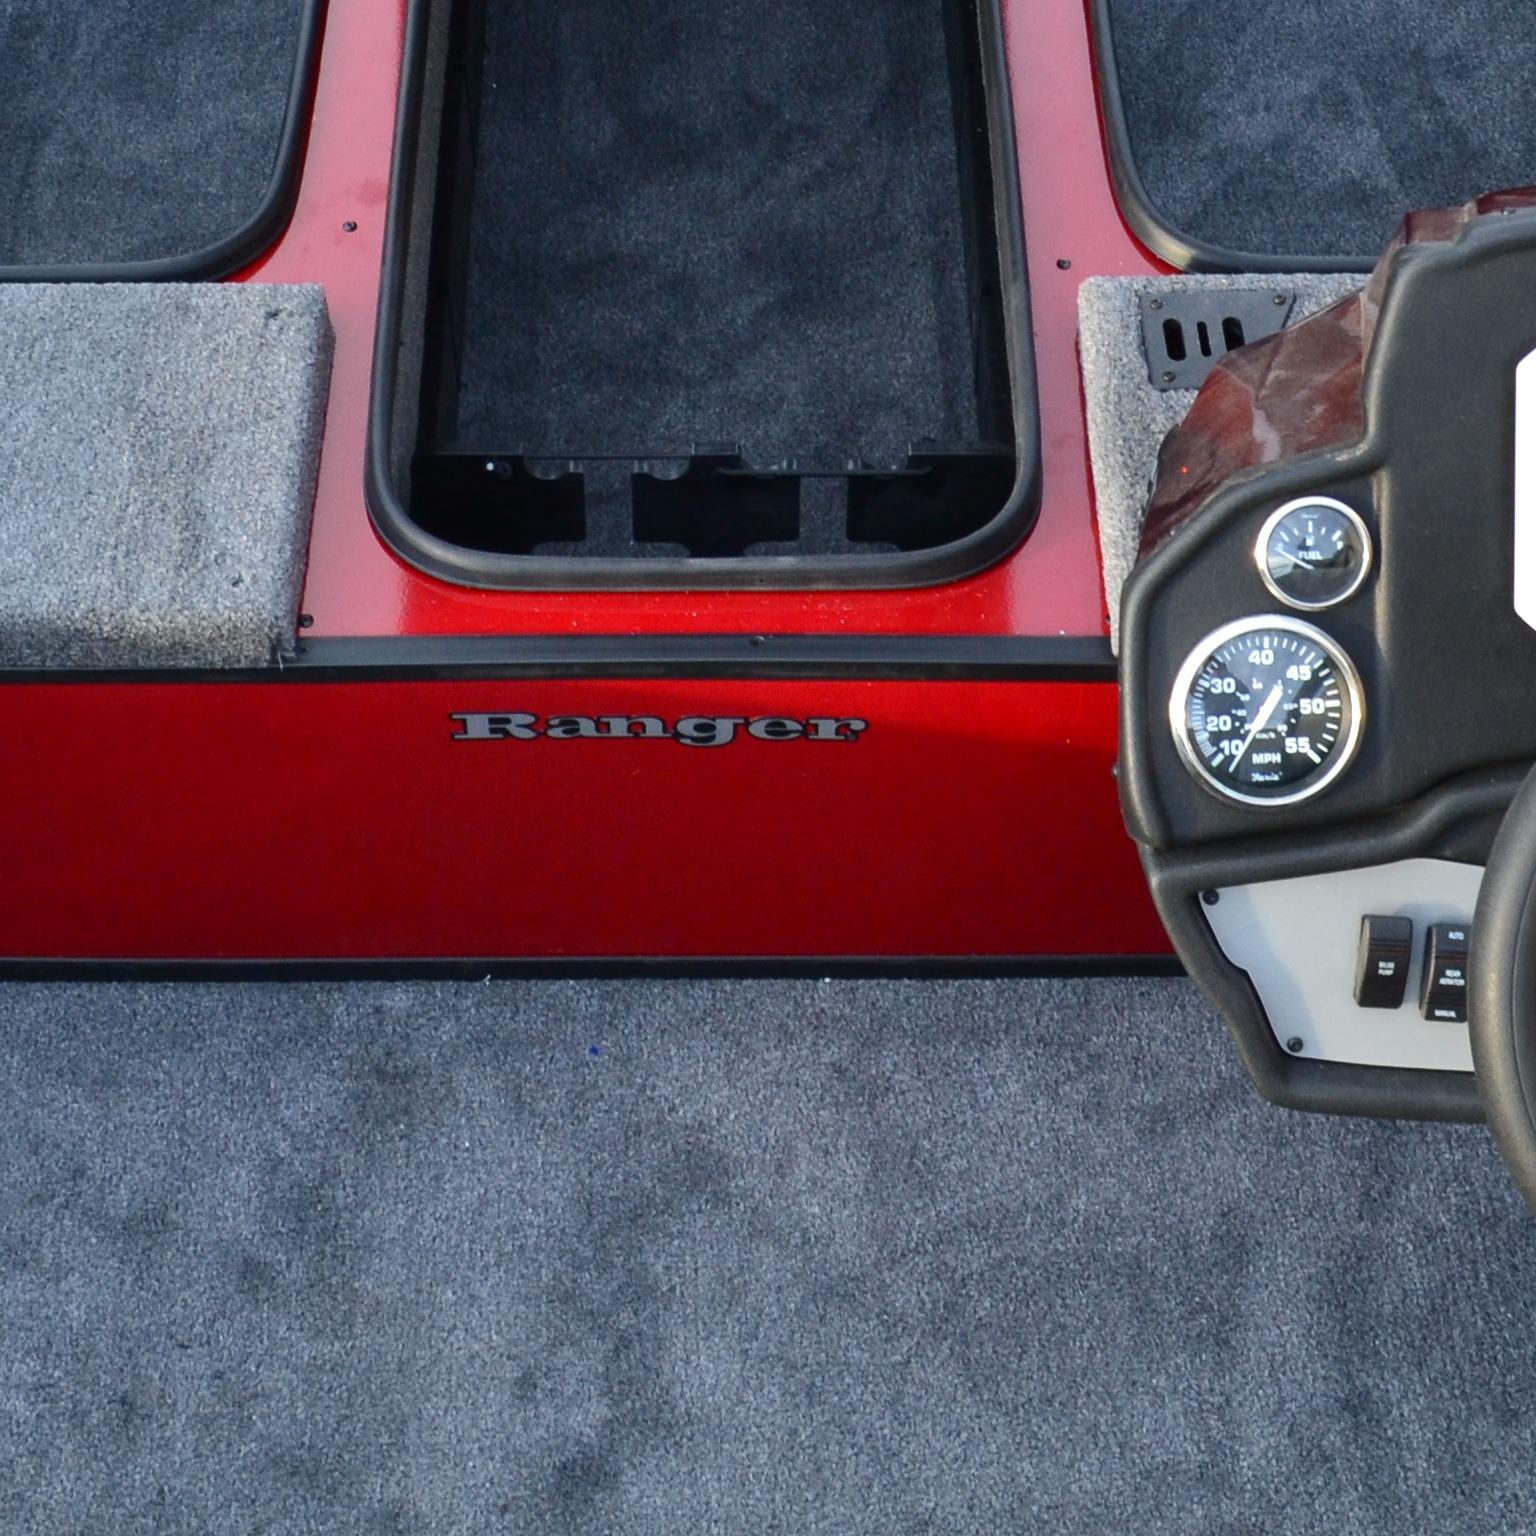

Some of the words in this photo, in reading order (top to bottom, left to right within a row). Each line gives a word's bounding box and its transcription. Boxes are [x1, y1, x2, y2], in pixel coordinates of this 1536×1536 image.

[1298, 551, 1323, 561] FUEL
[1248, 649, 1275, 665] 40
[1286, 664, 1312, 681] 45
[1210, 677, 1237, 694] 30
[1299, 697, 1326, 715] 50
[452, 712, 867, 746] Ranger
[1206, 714, 1232, 732] 20
[1219, 738, 1244, 756] 10
[1284, 736, 1311, 754] 55
[1252, 752, 1282, 764] MPH
